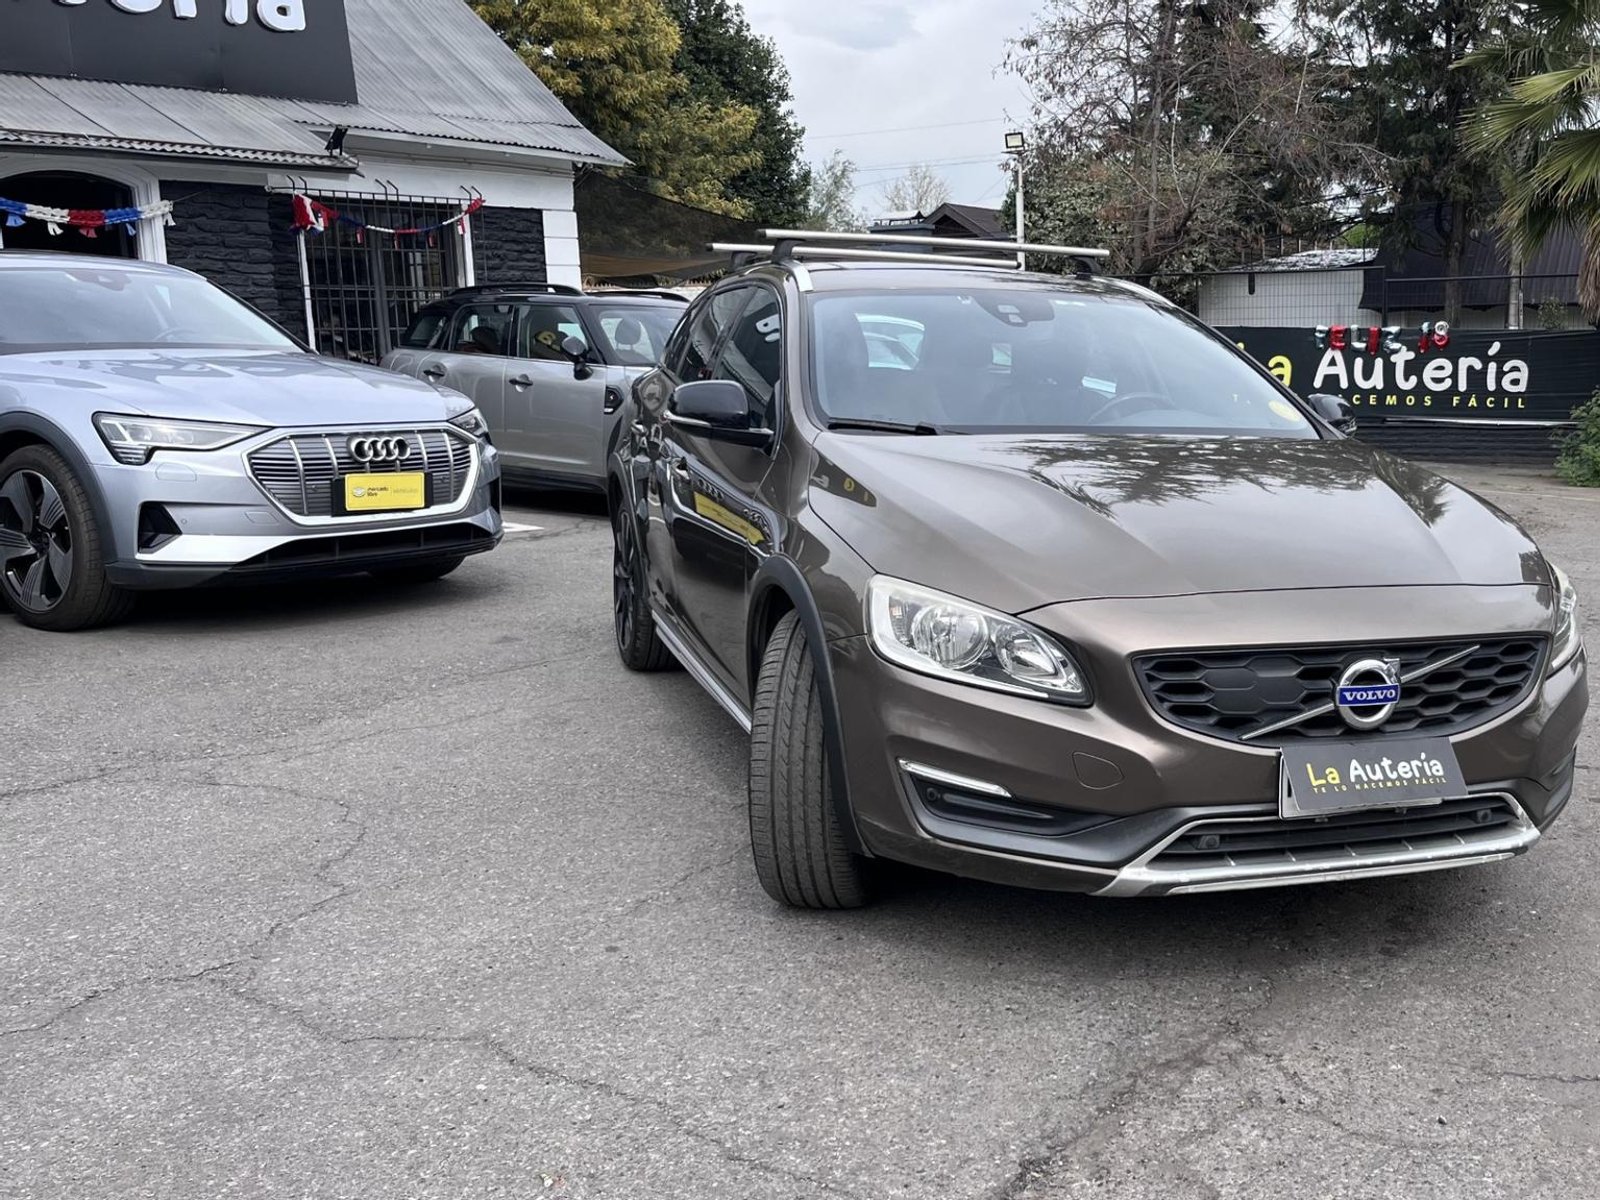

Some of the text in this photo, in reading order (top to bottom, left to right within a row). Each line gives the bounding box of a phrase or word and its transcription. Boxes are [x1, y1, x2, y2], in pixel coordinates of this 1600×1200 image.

[1418, 321, 1450, 353] 18
[1313, 341, 1529, 392] Autería
[1340, 393, 1526, 409] CEMOS FÁCIL
[1342, 689, 1396, 701] VOLVO
[1306, 752, 1444, 787] La Autería
[1355, 780, 1408, 791] HACEMOS
